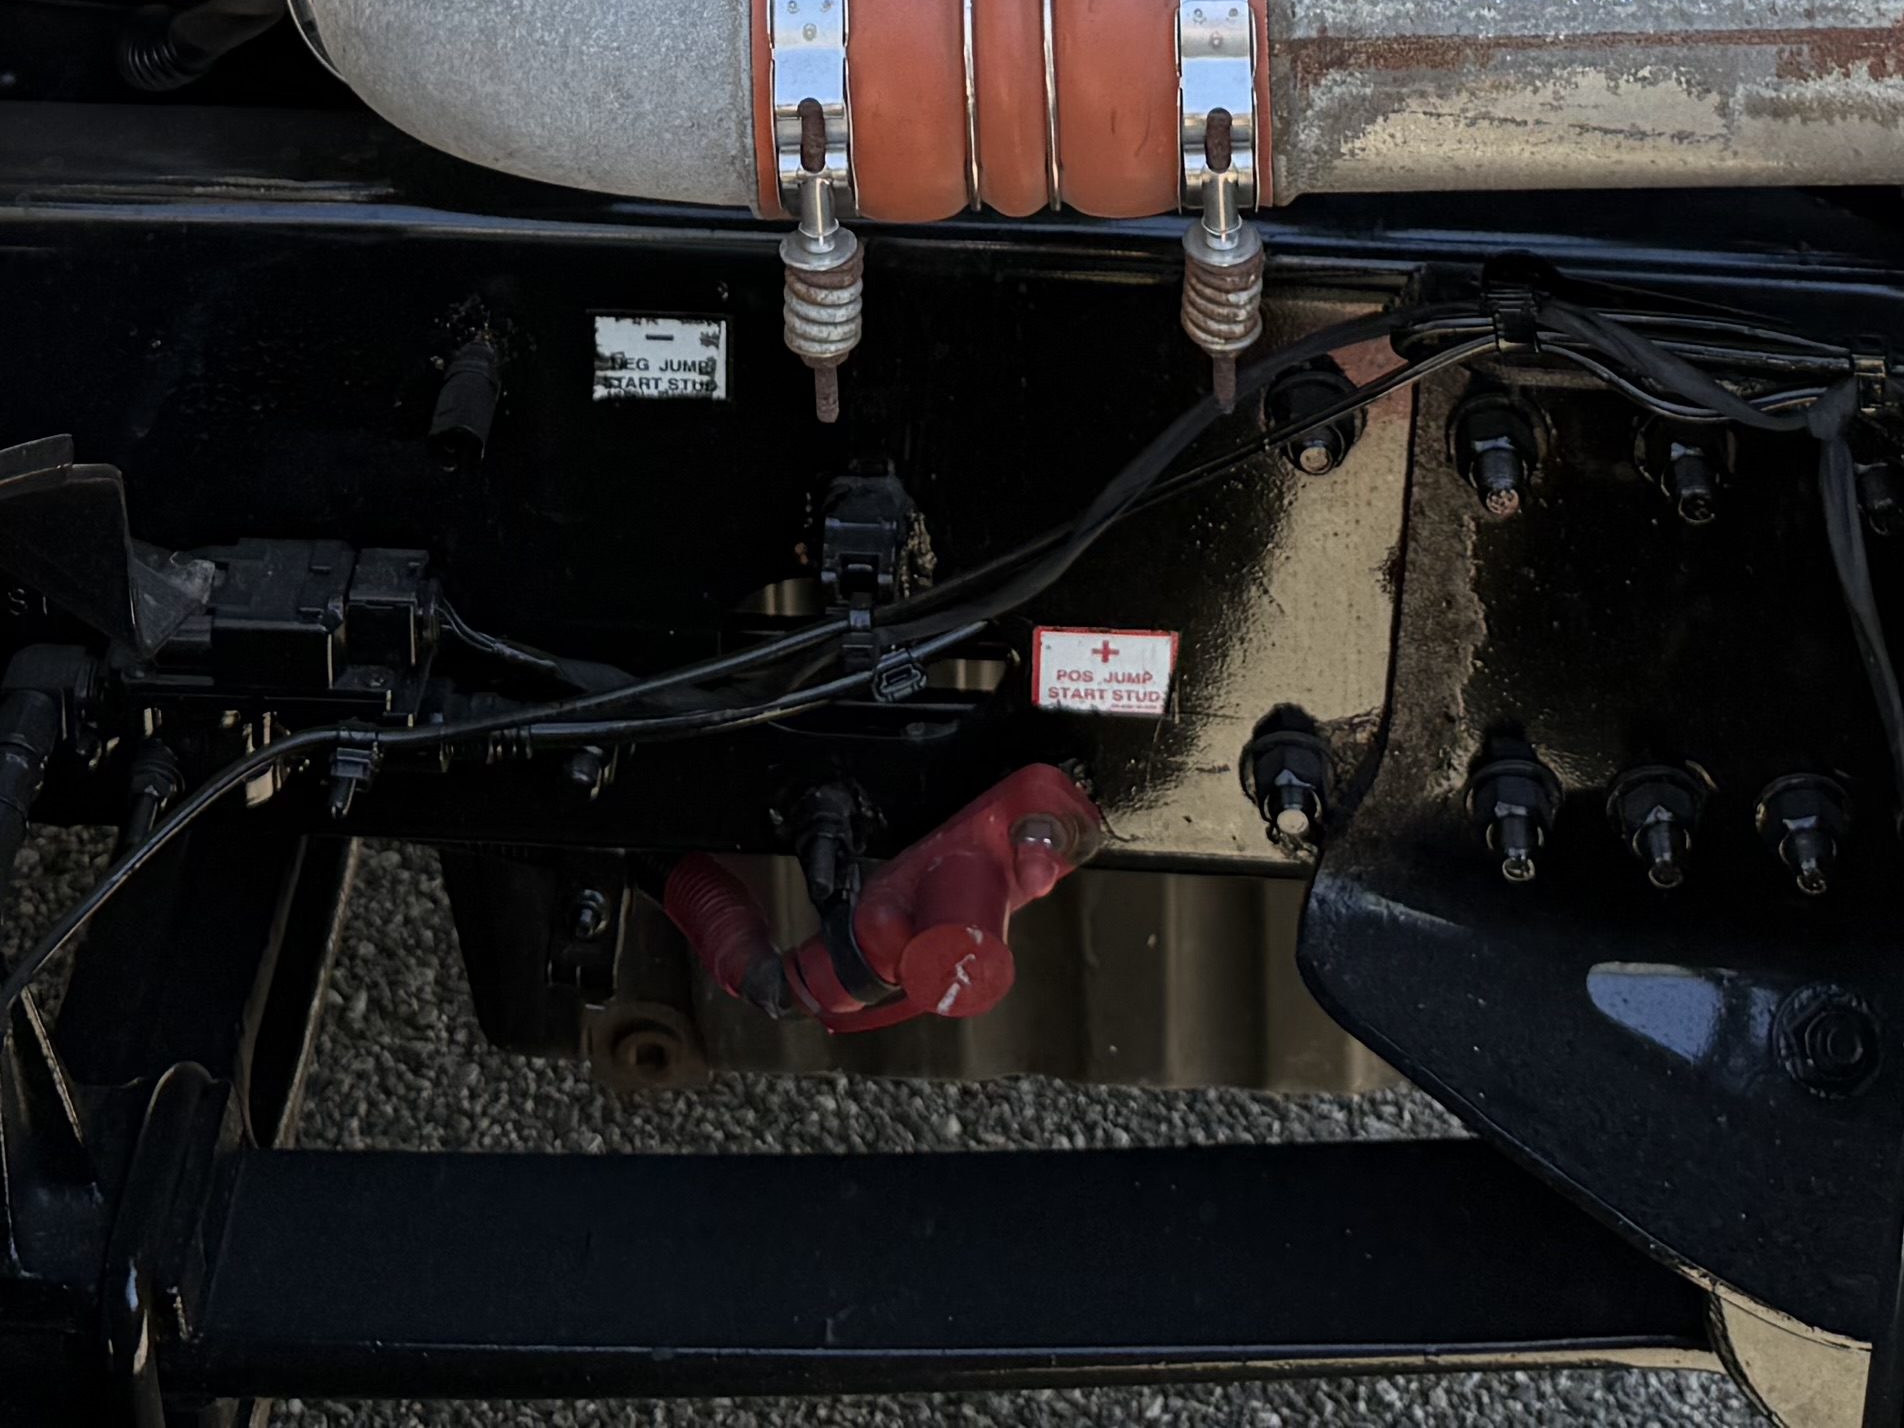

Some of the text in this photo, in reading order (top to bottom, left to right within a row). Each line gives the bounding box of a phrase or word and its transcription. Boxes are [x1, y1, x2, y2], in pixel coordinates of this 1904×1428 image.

[1056, 669, 1154, 685] POS JUMP
[1047, 686, 1161, 703] START STUD
